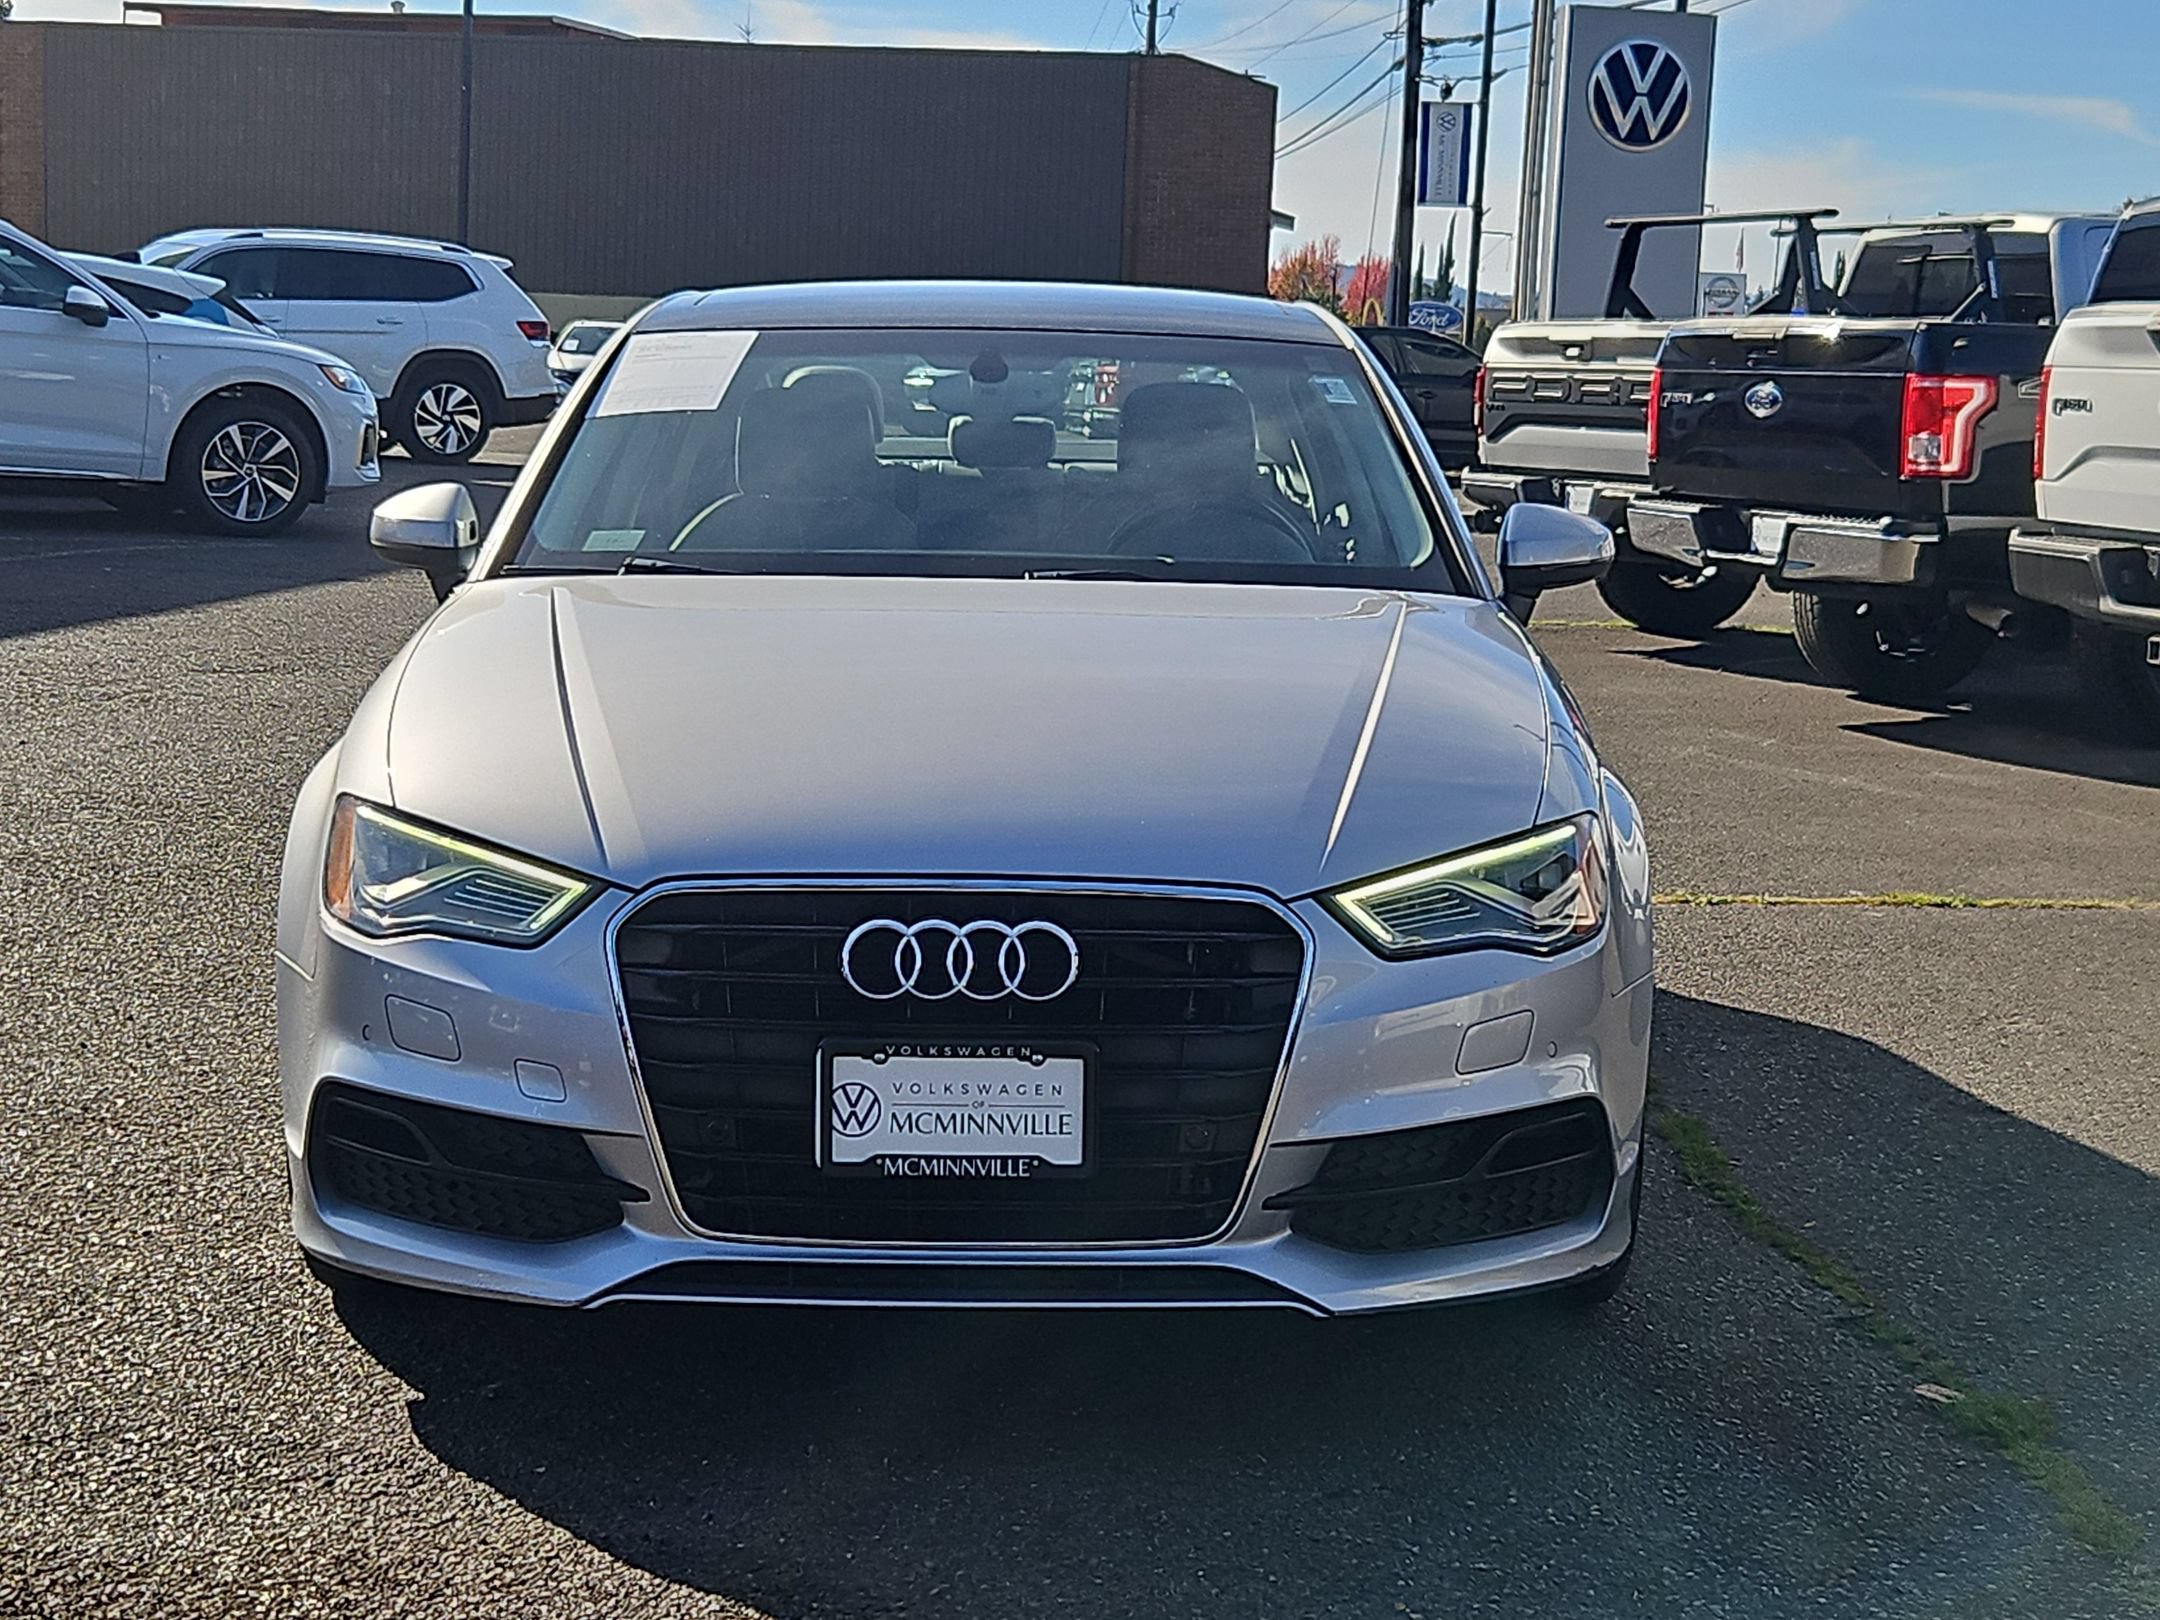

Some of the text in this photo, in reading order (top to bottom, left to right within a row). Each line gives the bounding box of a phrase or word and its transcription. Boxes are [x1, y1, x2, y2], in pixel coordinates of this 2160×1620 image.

[1591, 42, 1690, 148] VW
[886, 1045, 1031, 1057] VOLKSWAGEN
[892, 1082, 1062, 1096] VOLKSWAGEN
[889, 1111, 1072, 1136] MCMINNVILLE
[883, 1157, 1031, 1177] MCMINNVILLE
